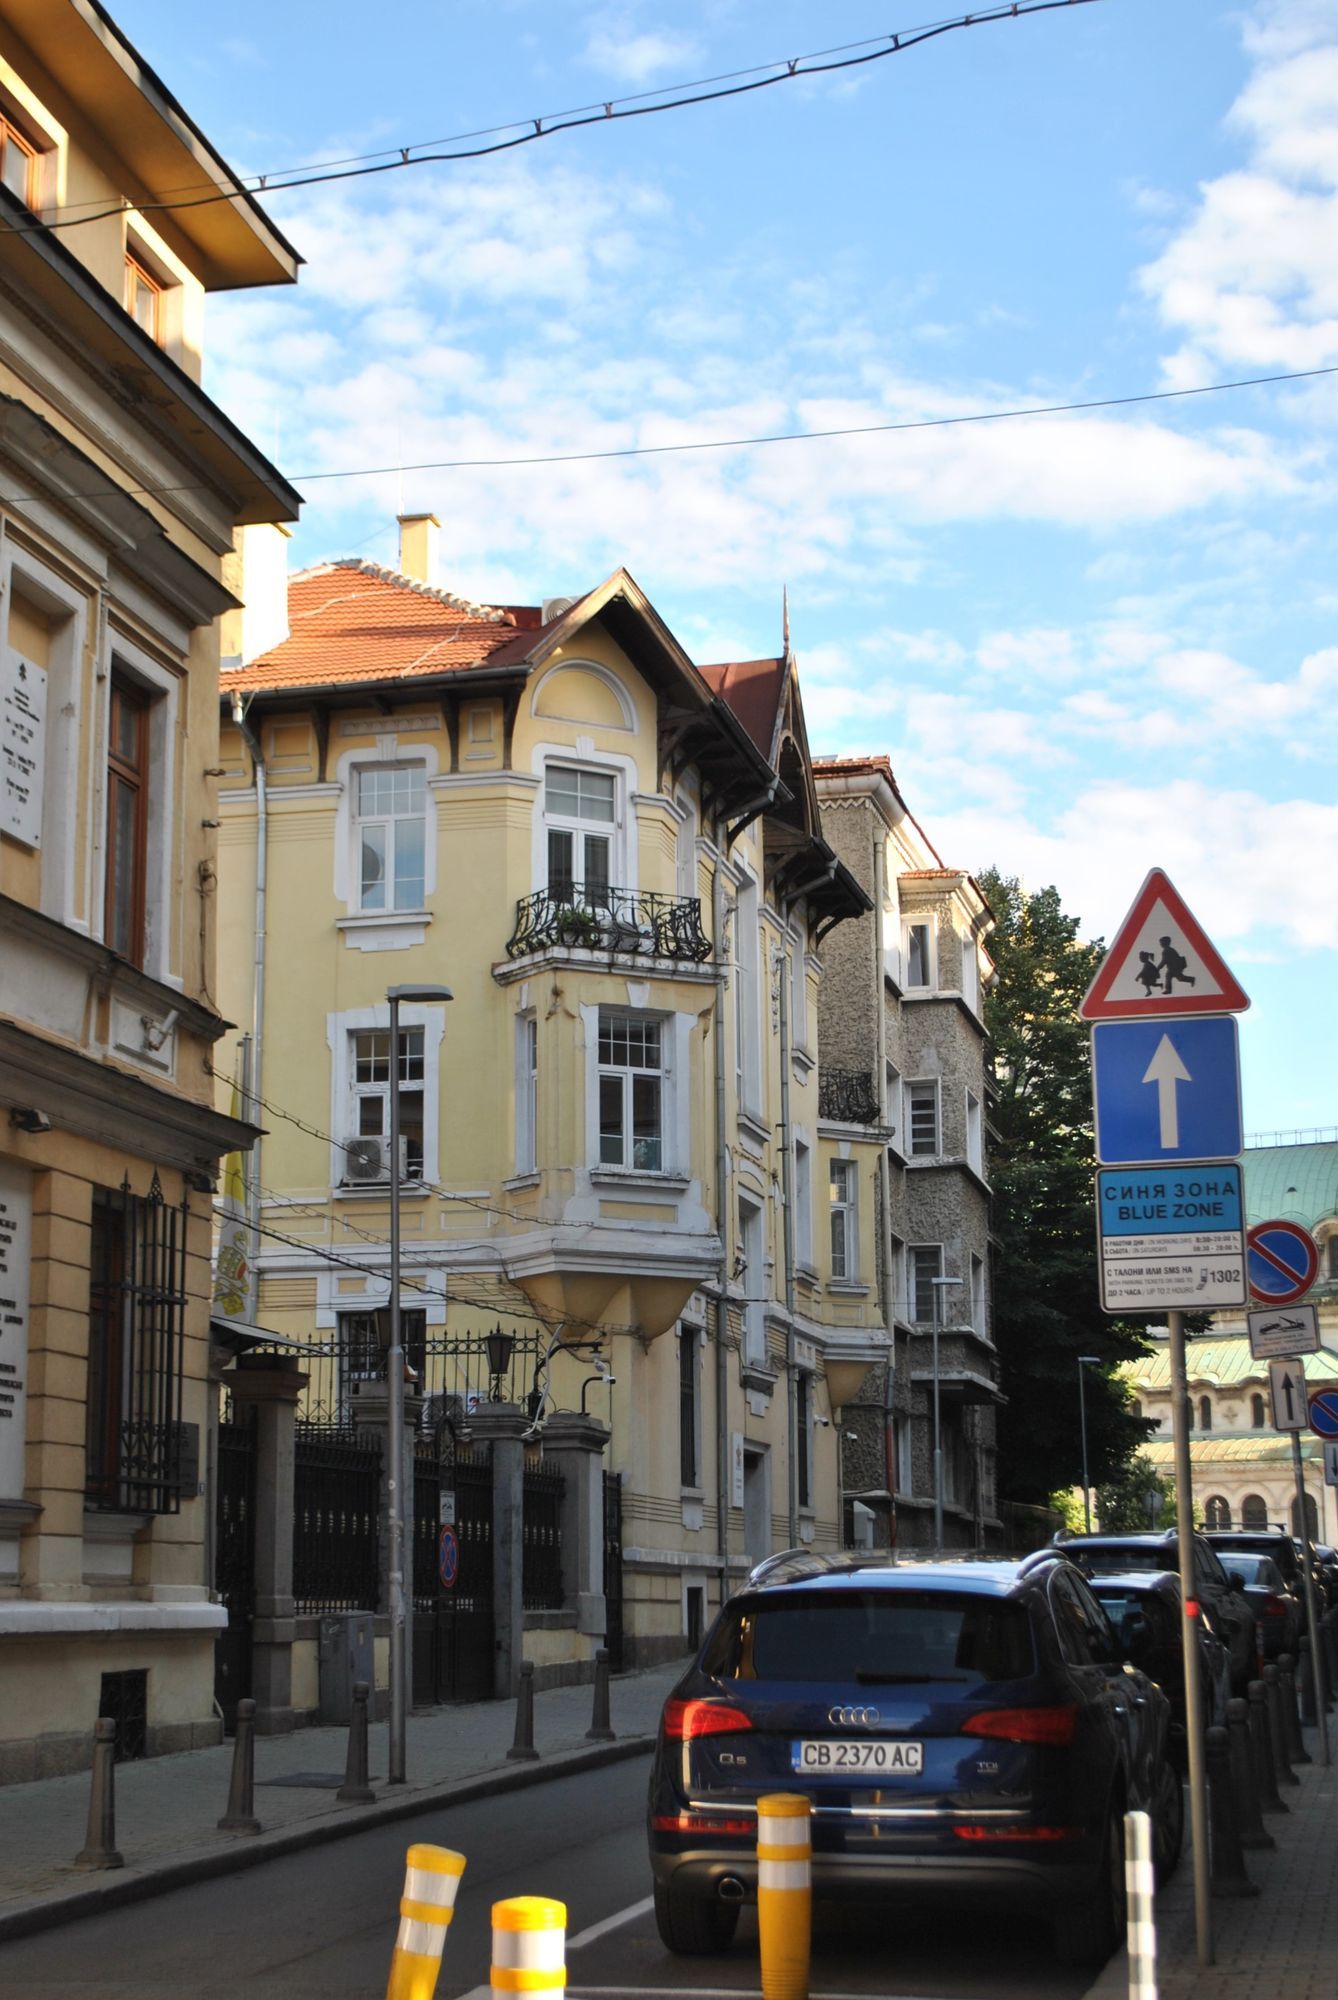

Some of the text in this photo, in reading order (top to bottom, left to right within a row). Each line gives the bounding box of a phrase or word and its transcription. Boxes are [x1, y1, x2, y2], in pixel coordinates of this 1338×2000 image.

[1104, 1182, 1236, 1200] СИНЯ ЗОНА
[1118, 1202, 1224, 1220] BLUE ZONE
[1210, 1270, 1241, 1283] 1302
[719, 1753, 747, 1765] Q5
[804, 1744, 831, 1766] CB
[835, 1745, 886, 1766] 2370
[892, 1746, 919, 1767] AC
